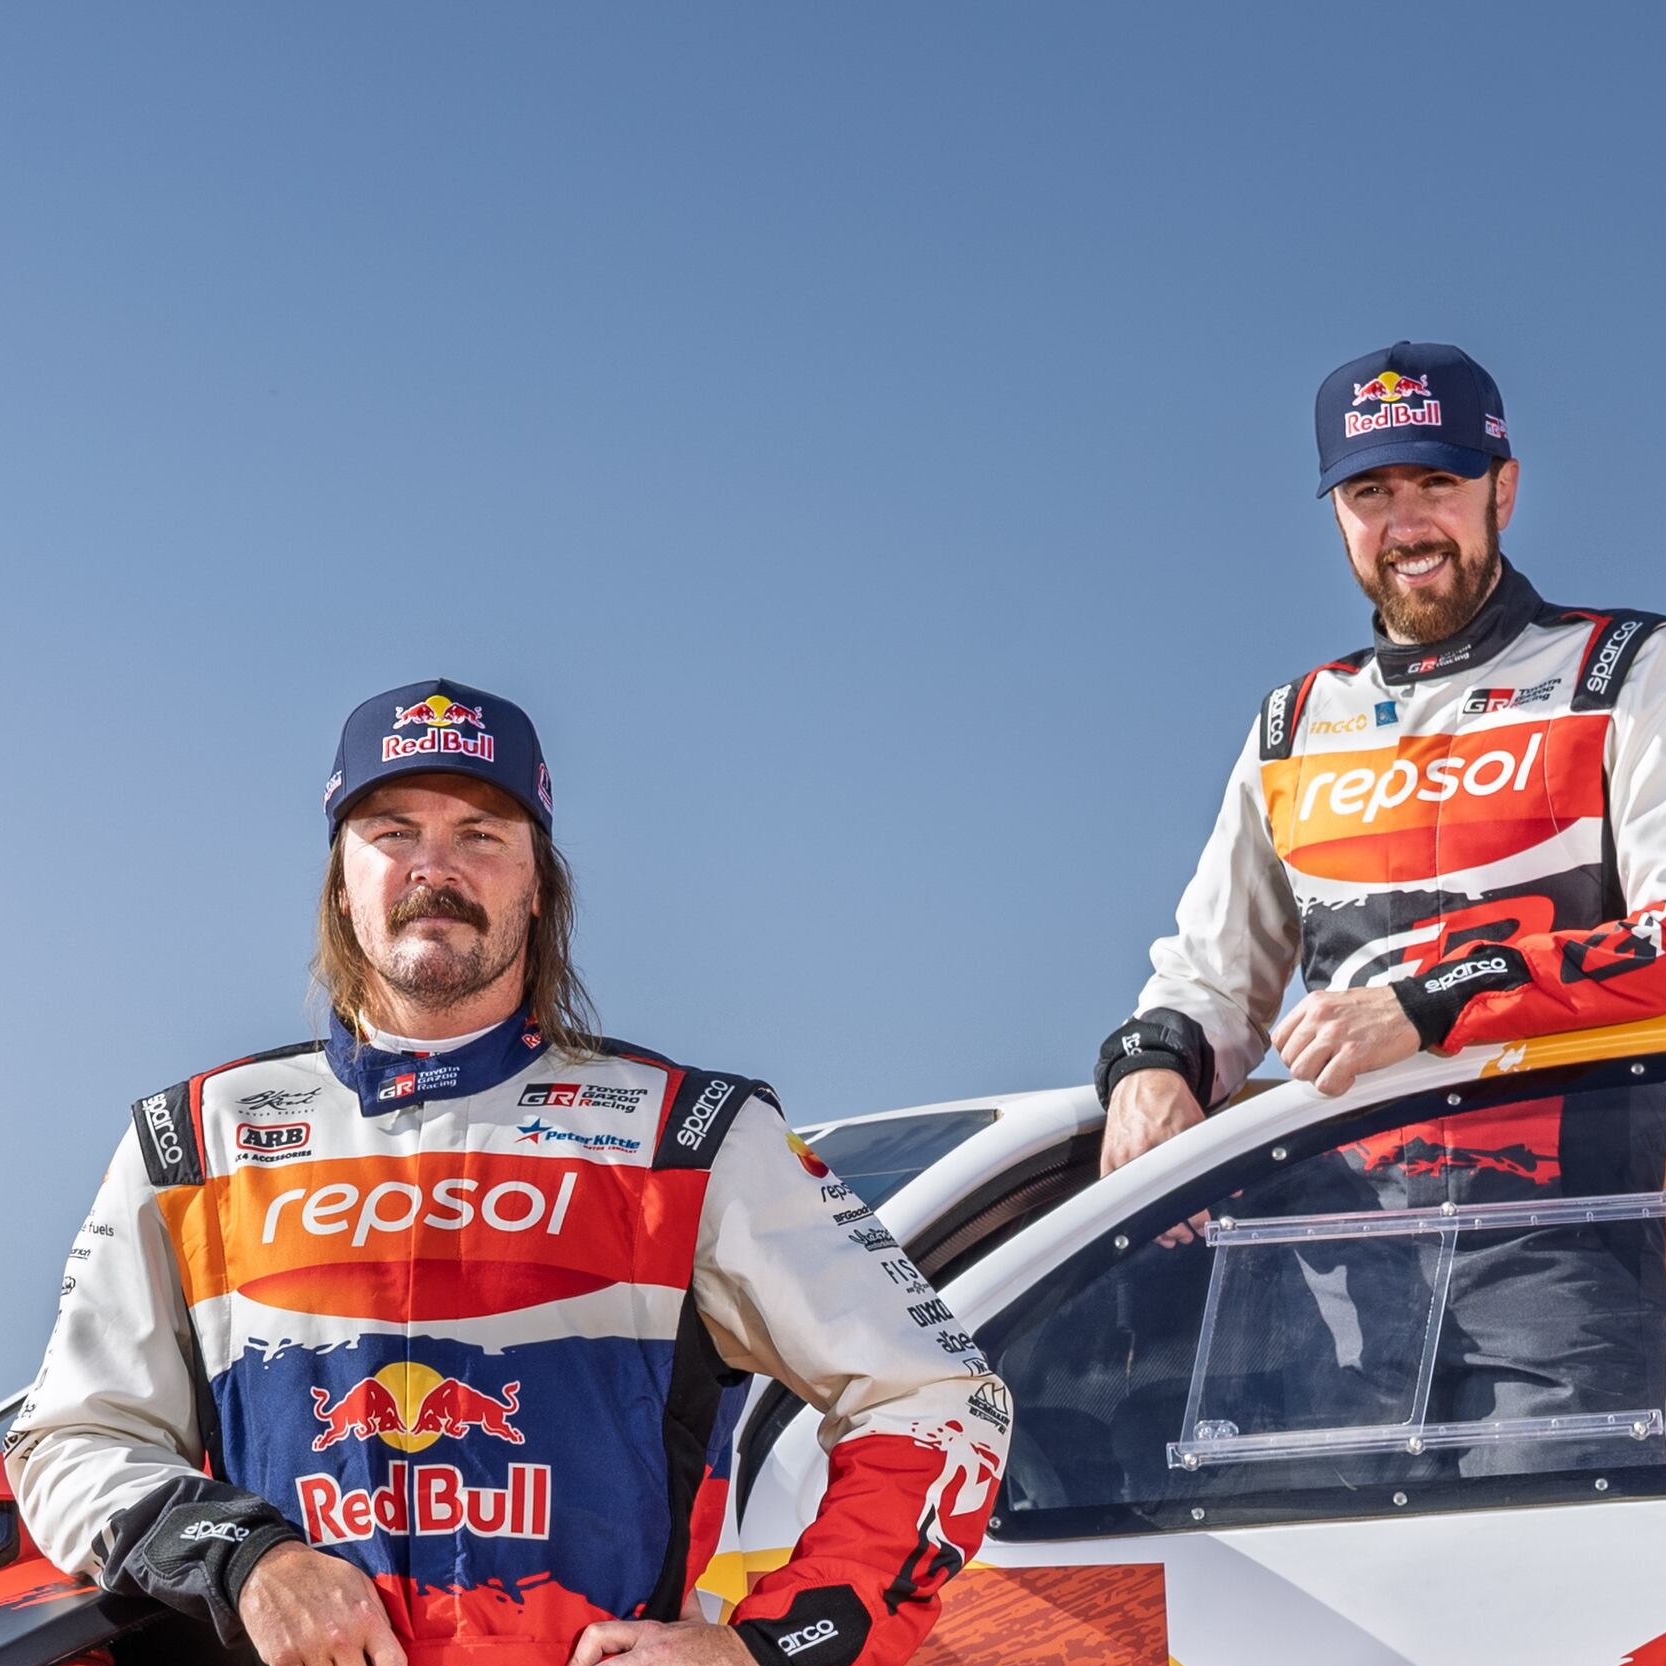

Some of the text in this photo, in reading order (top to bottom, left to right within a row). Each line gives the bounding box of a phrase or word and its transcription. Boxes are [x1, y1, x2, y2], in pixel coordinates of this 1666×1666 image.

[1345, 400, 1441, 438] Red Bull
[1407, 657, 1437, 674] GR
[1587, 621, 1643, 694] sparco
[1463, 688, 1514, 714] GR
[1267, 684, 1292, 750] sparco
[382, 728, 494, 762] Red Bull
[1299, 732, 1543, 823] repsol
[1425, 957, 1507, 994] sparco
[417, 1072, 457, 1083] GAZOO
[418, 1066, 460, 1078] TOYOTA
[379, 1081, 413, 1100] GR
[417, 1079, 457, 1091] Racing
[586, 1085, 648, 1096] TOYOTA
[520, 1091, 576, 1107] GR
[579, 1099, 636, 1113] Racing
[581, 1092, 640, 1104] GAZOO
[677, 1079, 735, 1151] sparco
[142, 1093, 183, 1169] sparco
[242, 1127, 303, 1148] ARB
[545, 1131, 641, 1149] Peter Kittle
[251, 1150, 312, 1163] ACCESSORIES
[261, 1171, 578, 1247] repsol
[833, 1205, 874, 1223] BFGood
[89, 1222, 114, 1237] fuels
[294, 1460, 551, 1548] Red Bull
